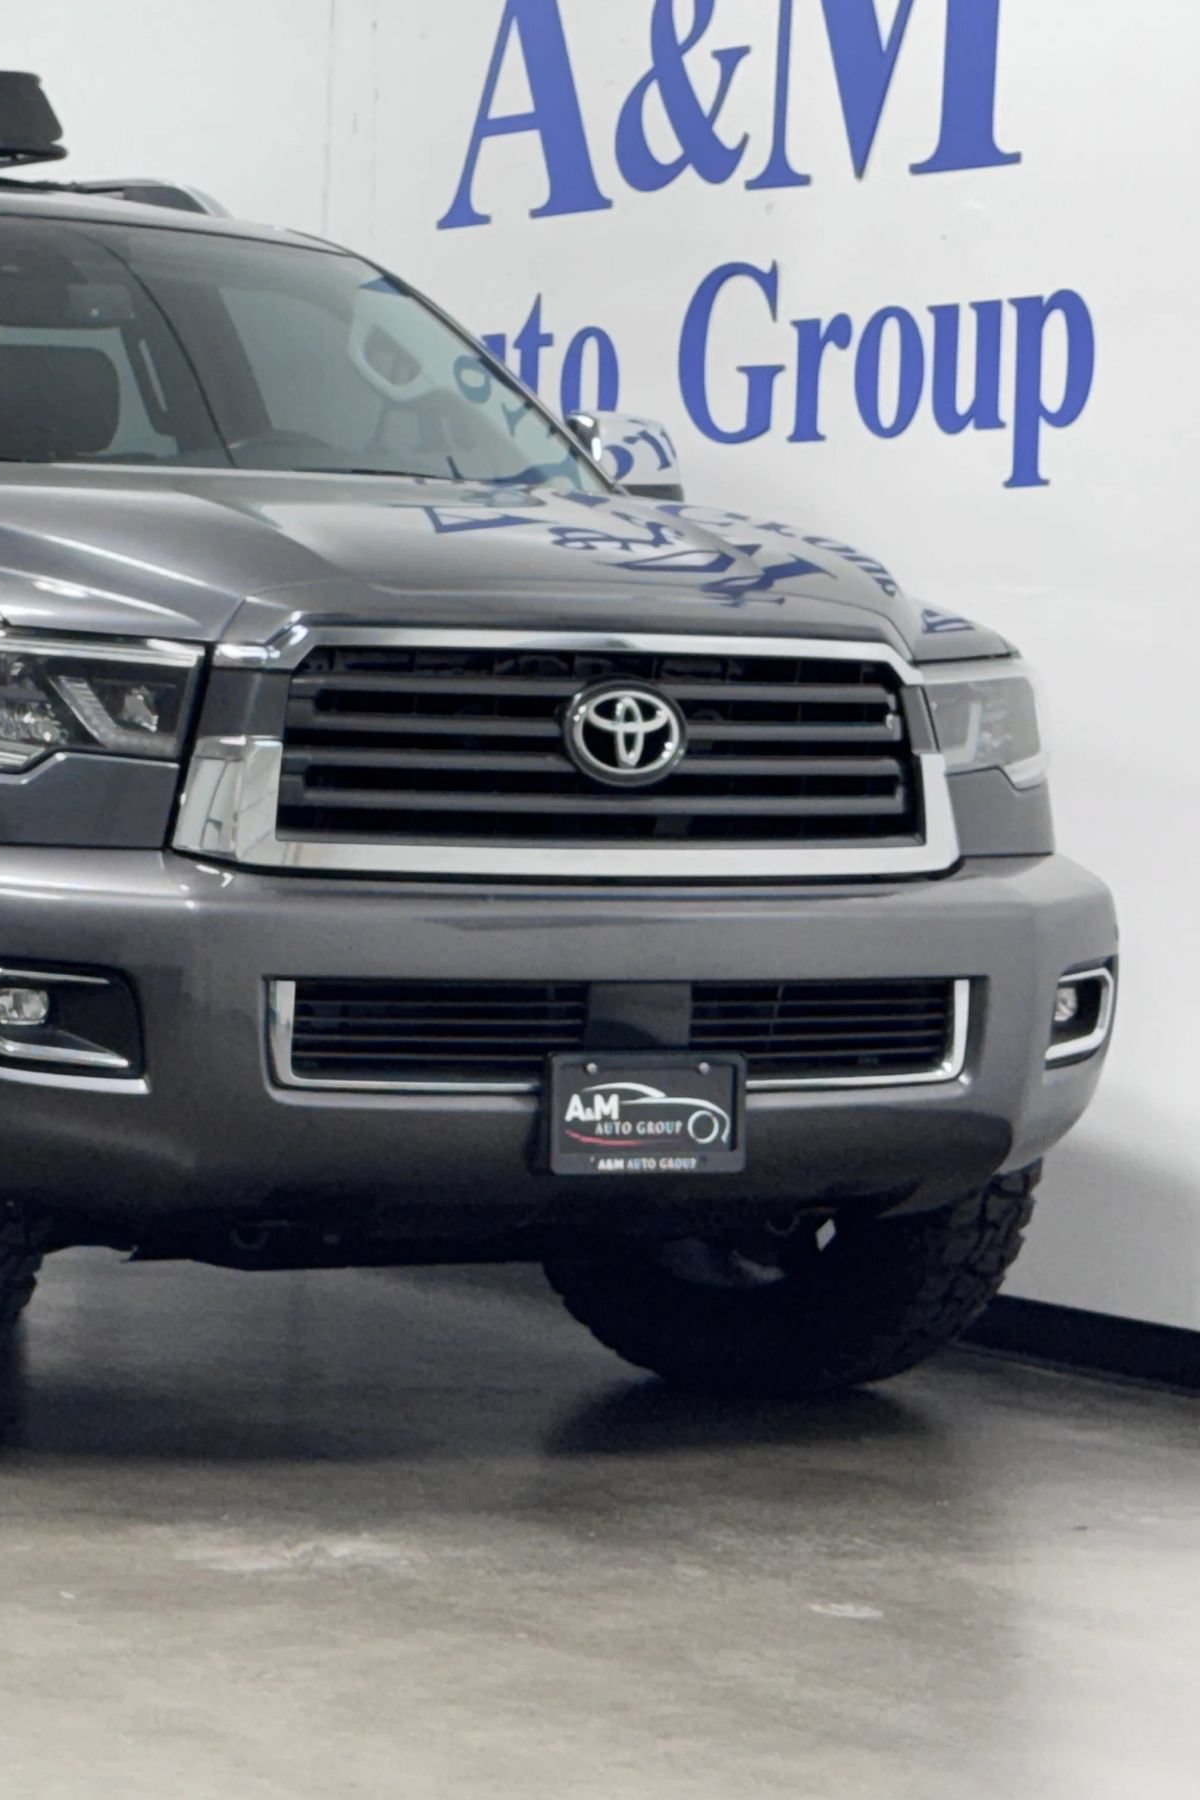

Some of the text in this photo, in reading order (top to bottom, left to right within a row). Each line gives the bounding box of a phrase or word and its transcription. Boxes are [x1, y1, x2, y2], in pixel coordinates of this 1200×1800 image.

[437, 0, 1022, 230] A&M
[678, 260, 1095, 488] Group
[565, 1094, 620, 1122] A&M
[595, 1121, 683, 1136] AUTO GROUP
[626, 1157, 657, 1170] AUTO
[659, 1157, 697, 1170] GROUP
